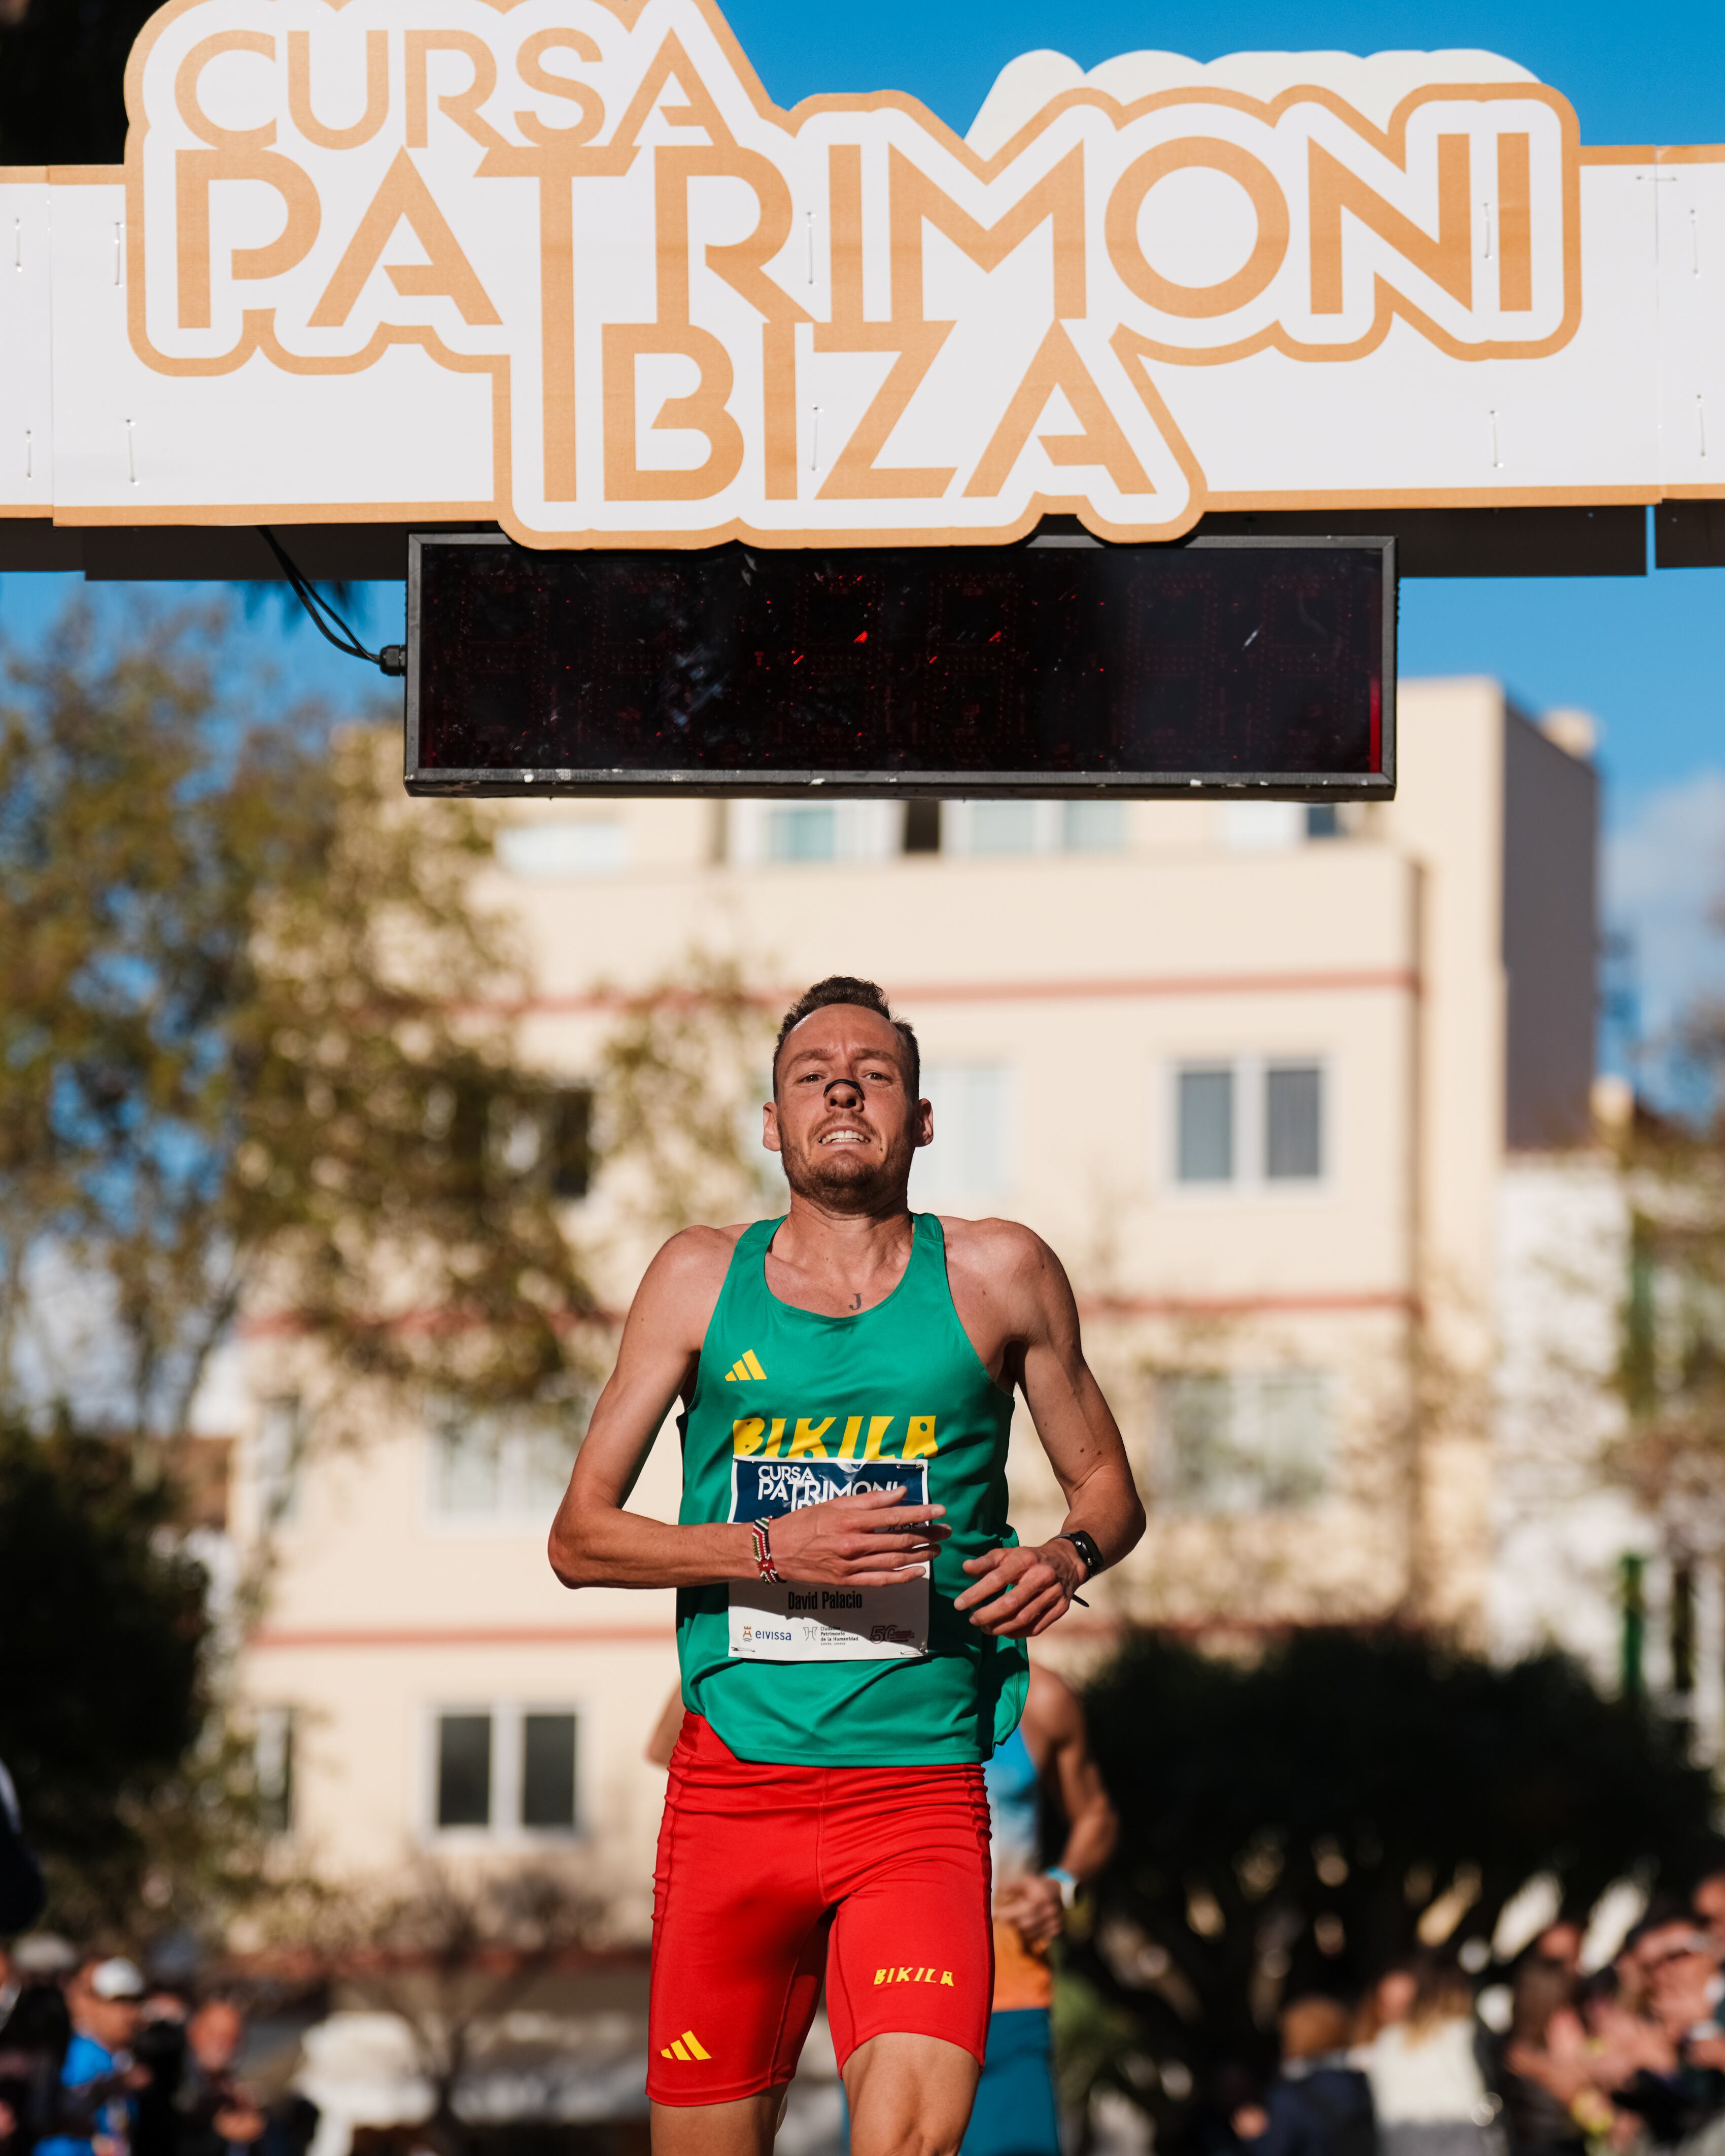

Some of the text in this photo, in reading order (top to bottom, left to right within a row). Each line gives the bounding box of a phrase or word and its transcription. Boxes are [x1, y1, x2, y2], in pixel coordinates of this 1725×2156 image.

[174, 26, 739, 151] CURSA
[175, 132, 1533, 329] PATRIMONI
[733, 1415, 939, 1460] BIKILA
[758, 1465, 815, 1481] CURSA
[788, 1590, 862, 1610] David Palacio
[755, 1630, 791, 1641] eivissa
[873, 1967, 954, 1987] BIKILA
